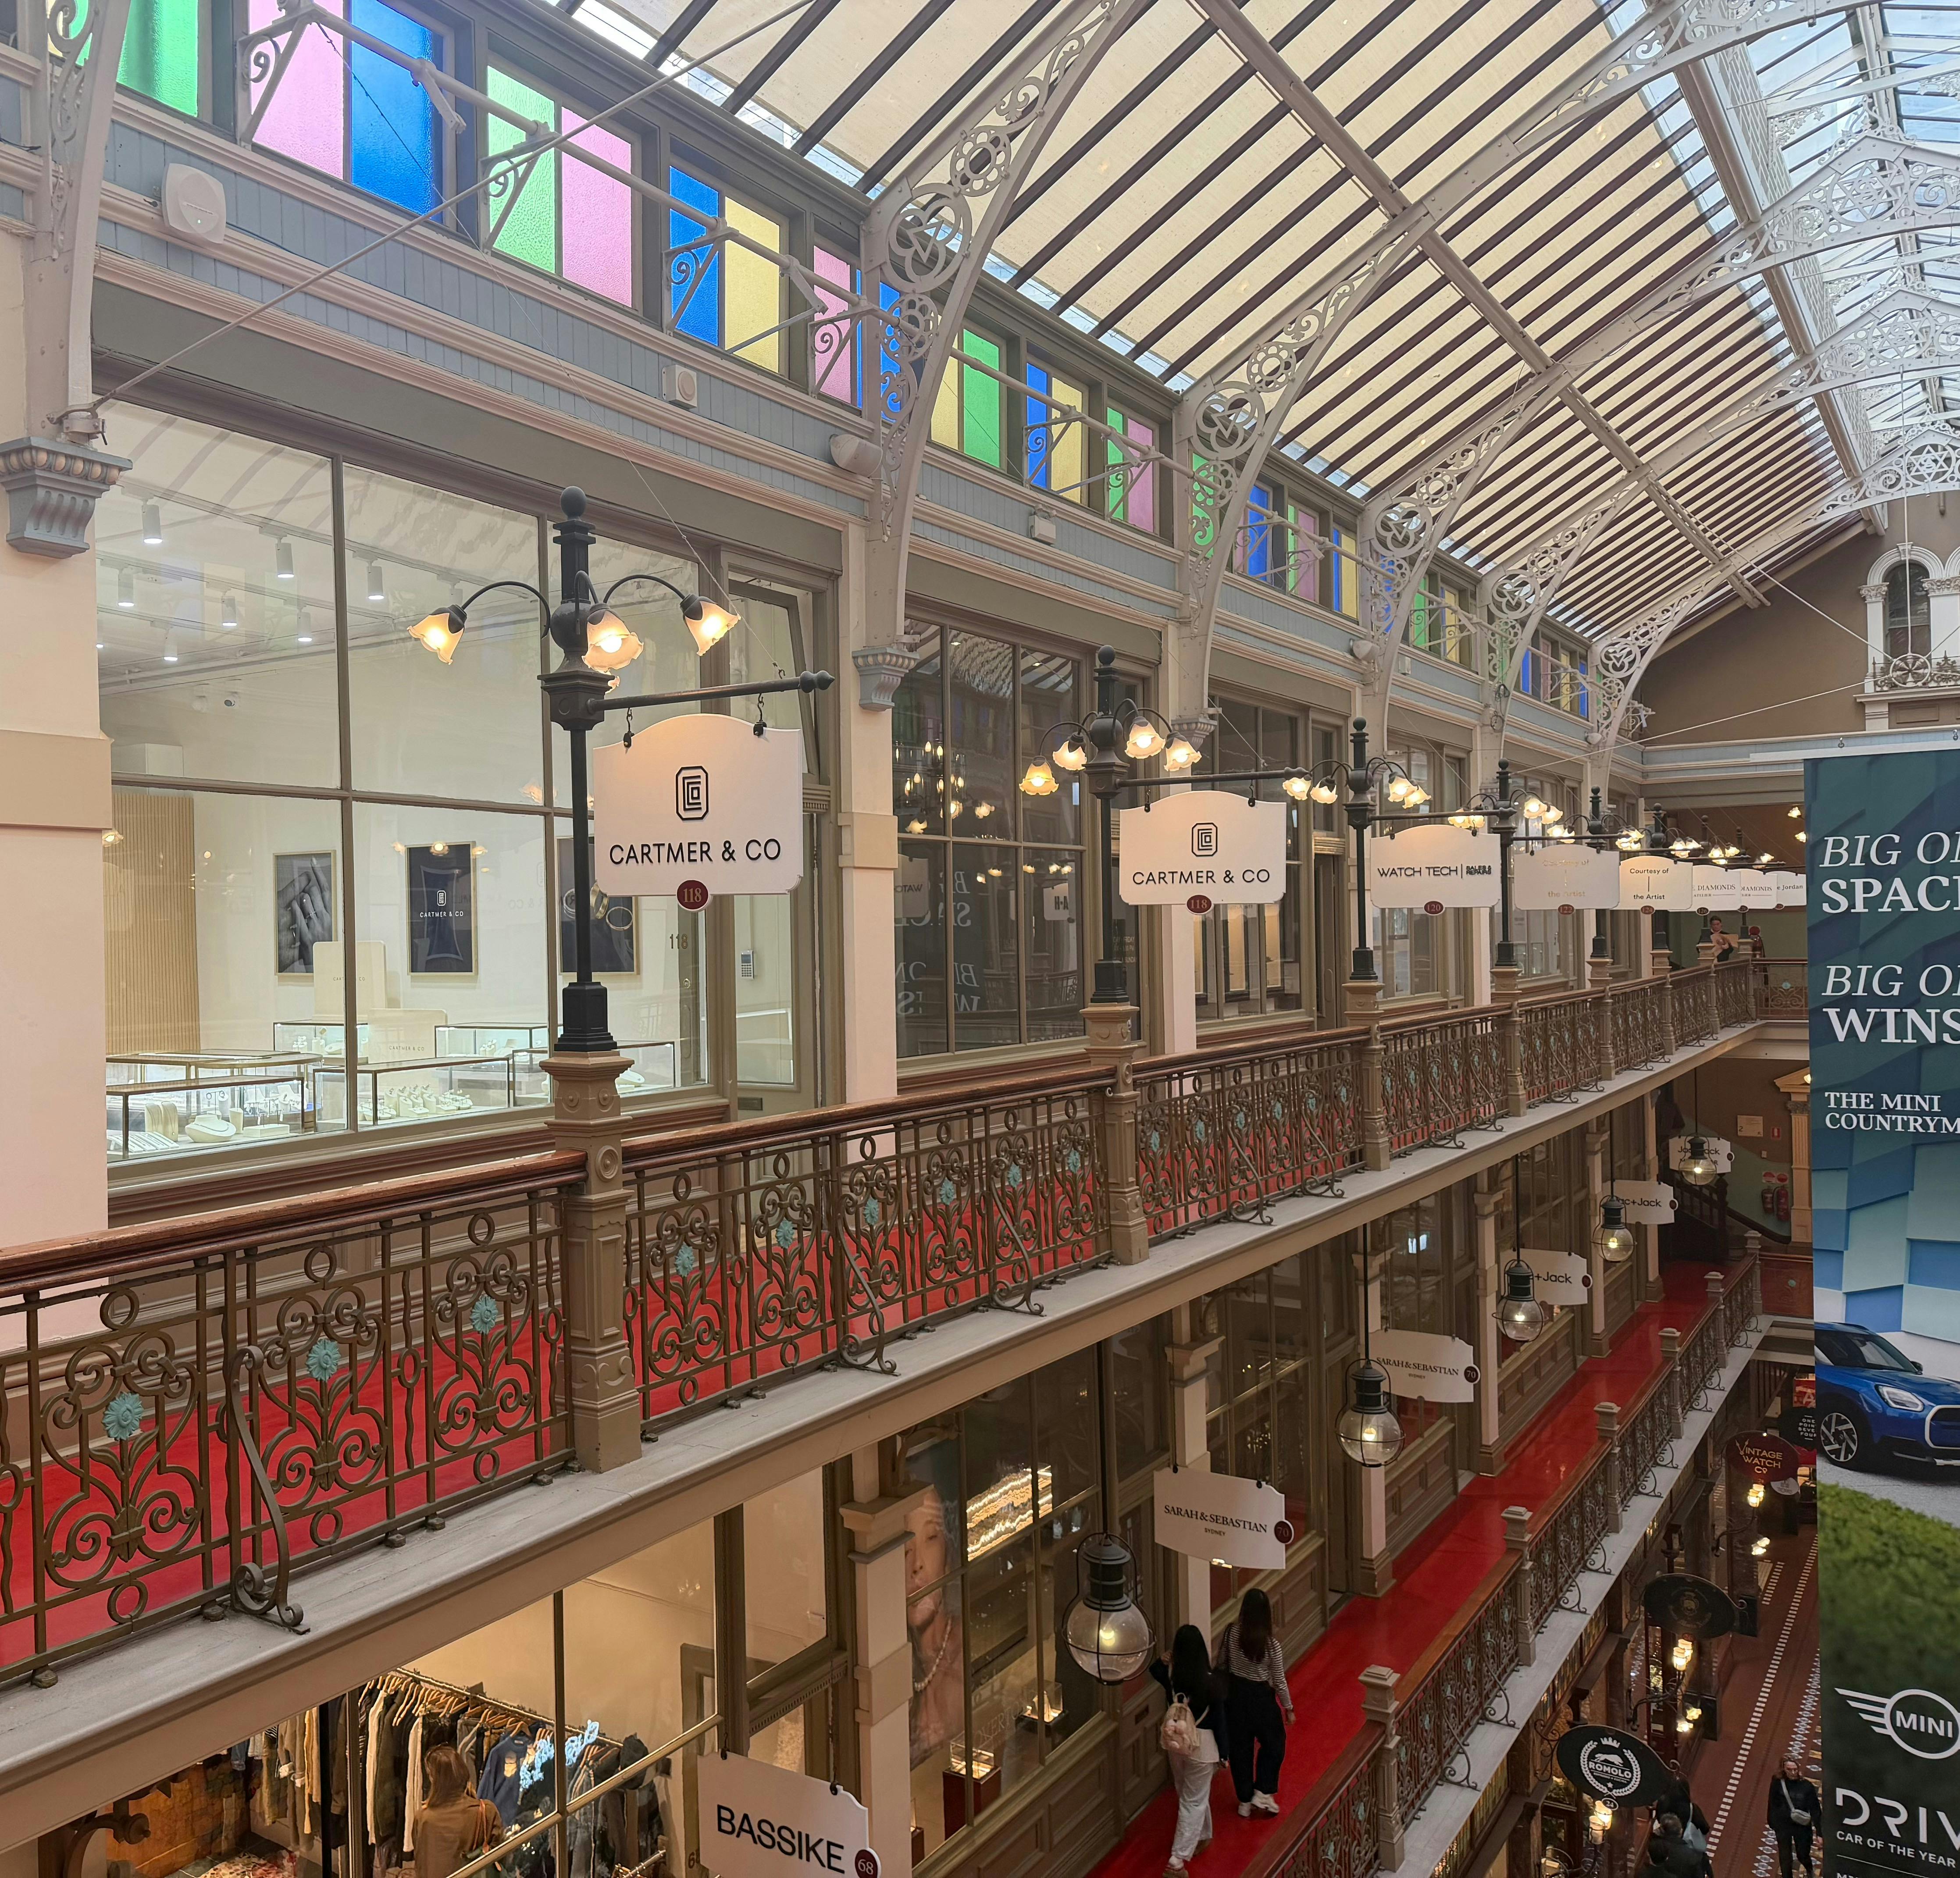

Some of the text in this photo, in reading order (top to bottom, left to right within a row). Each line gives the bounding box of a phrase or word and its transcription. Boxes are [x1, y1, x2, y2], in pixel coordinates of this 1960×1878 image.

[609, 838, 781, 865] CARTMER & CO
[1819, 831, 1960, 867] BIG O
[1132, 869, 1270, 885] CARTMER & CO
[1377, 866, 1458, 877] WATCH TECH
[683, 887, 702, 903] 118
[1190, 899, 1208, 909] 118
[1427, 904, 1440, 912] 120
[669, 934, 688, 949] 118
[1821, 964, 1960, 997] BIG O
[1822, 1008, 1960, 1044] WINS
[1825, 1092, 1942, 1112] THE MINI
[1616, 1197, 1662, 1207] ac+Jack
[1376, 1357, 1404, 1368] SARAH
[1412, 1362, 1459, 1376] SEBASTIAN
[1466, 1370, 1476, 1379] 70
[1735, 1438, 1783, 1460] VINTAGE
[1743, 1455, 1781, 1469] WATCH
[1164, 1504, 1268, 1533] SARAH & SEBASTIAN
[1204, 1527, 1226, 1536] SYDNEY
[1276, 1526, 1289, 1537] 70
[1896, 1710, 1953, 1739] MINI
[1588, 1761, 1632, 1779] ROMOLO
[716, 1803, 845, 1874] BASSIKE
[1836, 1830, 1956, 1868] CAR OF THE YEAR
[858, 1859, 874, 1875] 68
